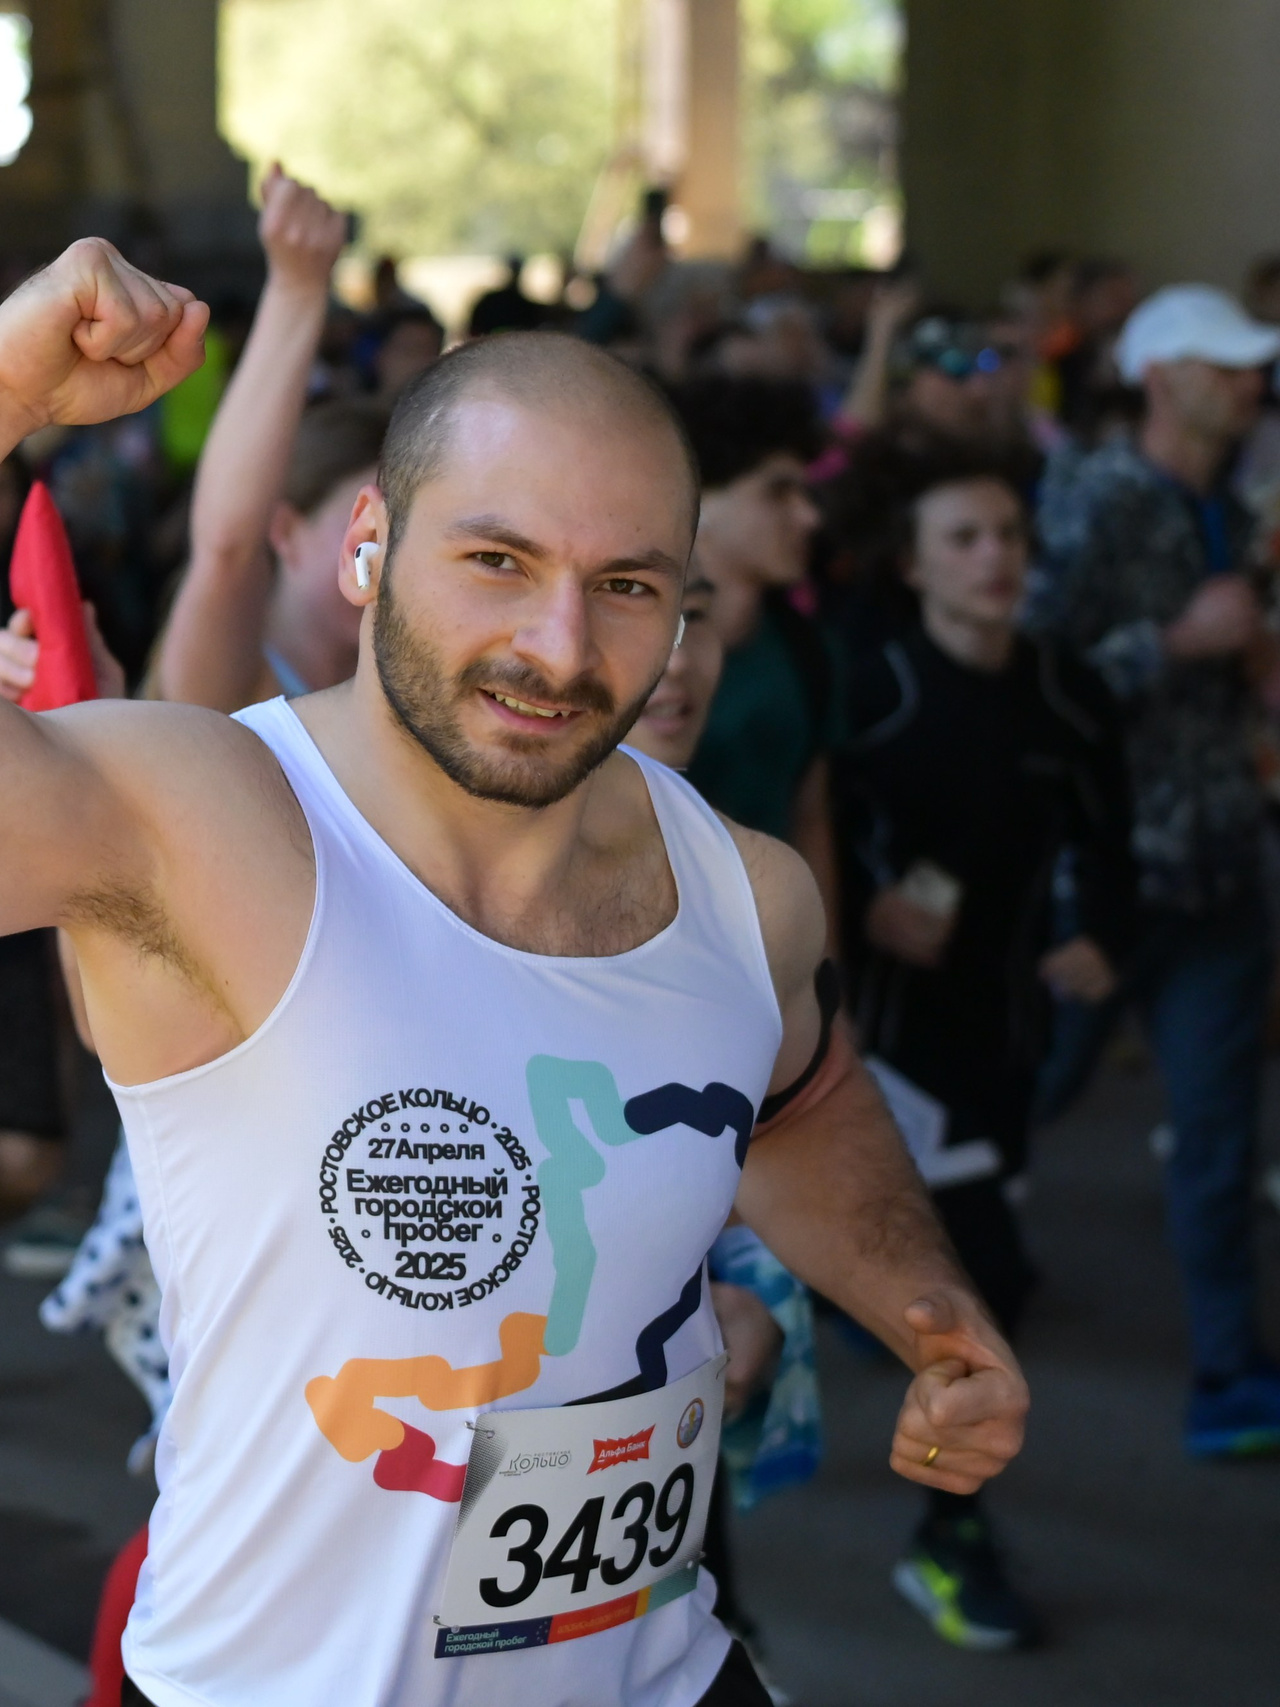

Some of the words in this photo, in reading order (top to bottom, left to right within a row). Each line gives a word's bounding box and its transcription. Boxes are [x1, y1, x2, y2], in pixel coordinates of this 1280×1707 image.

[399, 1088, 490, 1125] КОЛЬЦО
[319, 1093, 400, 1214] РОСТОВСКОЕ
[494, 1127, 532, 1171] 2025
[346, 1167, 508, 1199] Ежегодный
[354, 1191, 502, 1222] городской
[328, 1226, 363, 1268] 2025
[384, 1215, 483, 1247] пробег
[455, 1185, 541, 1307] РОСТОВСКОЕ
[395, 1251, 467, 1280] 2025
[365, 1272, 454, 1310] КОЛЬЦО
[479, 1462, 695, 1608] 3439
[444, 1638, 493, 1653] городской
[495, 1636, 528, 1649] пробег
[446, 1629, 499, 1642] Ежегодный
